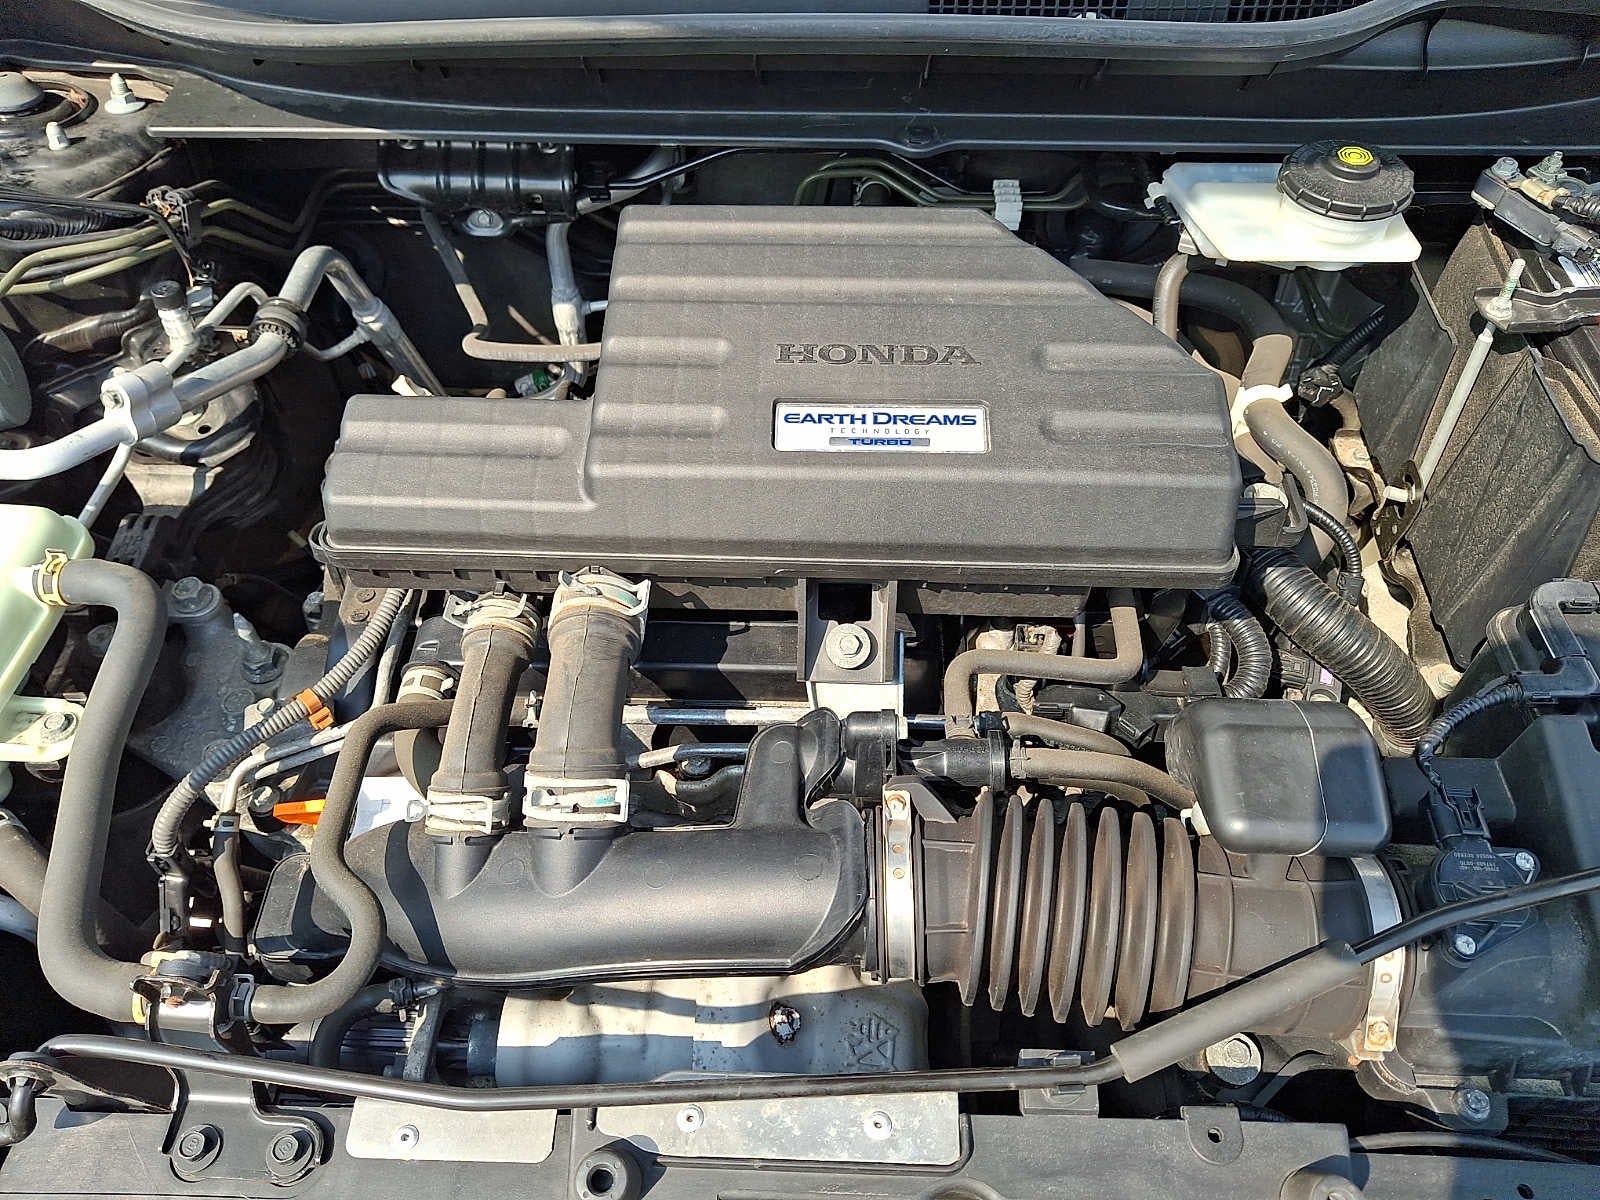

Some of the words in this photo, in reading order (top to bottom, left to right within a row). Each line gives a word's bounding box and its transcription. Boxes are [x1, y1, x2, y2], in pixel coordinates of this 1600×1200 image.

[775, 344, 982, 366] HONDA
[784, 412, 867, 425] EARTH
[872, 411, 977, 426] DREAMS
[830, 427, 930, 435] TECHNOLOGY
[848, 438, 912, 446] TURBO
